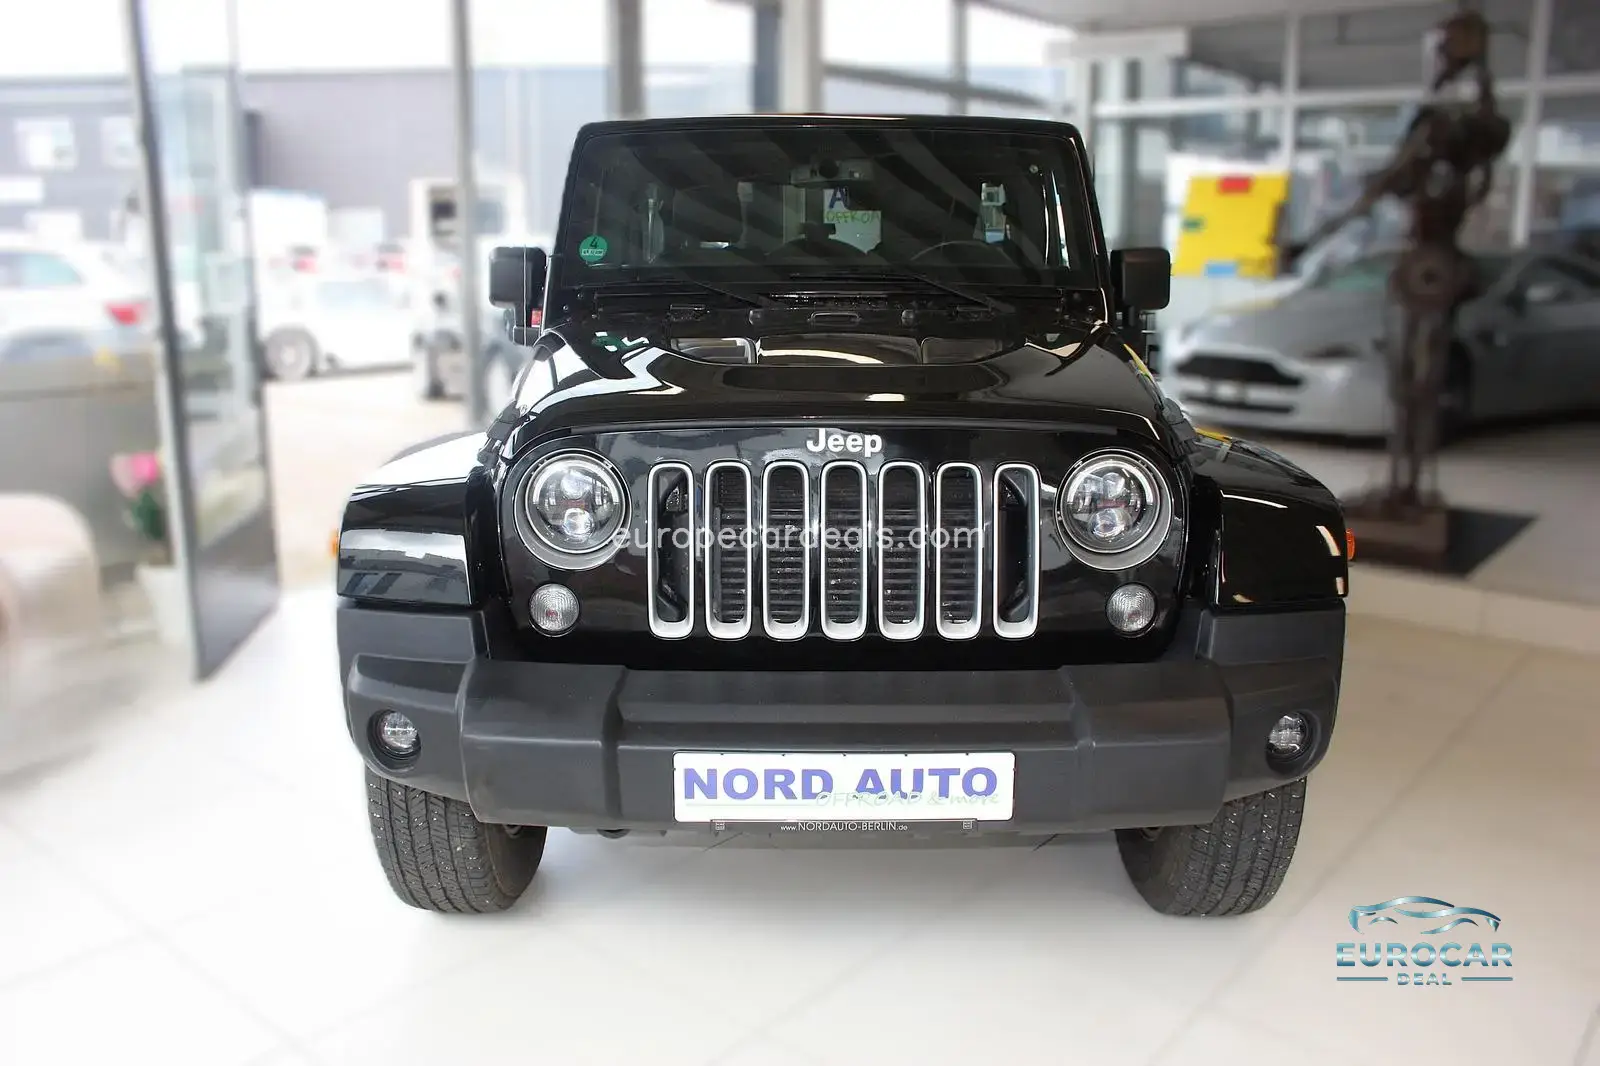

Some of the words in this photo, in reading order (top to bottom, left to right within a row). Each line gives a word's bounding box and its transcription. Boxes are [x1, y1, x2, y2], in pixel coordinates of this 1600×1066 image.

[590, 236, 600, 249] 4
[806, 428, 882, 457] Jeep
[684, 768, 834, 800] NORD
[855, 767, 998, 799] AUTO
[816, 791, 922, 807] OFFROAD
[949, 791, 999, 806] more
[780, 821, 908, 832] www.NORDAUTO-BERLIN.de
